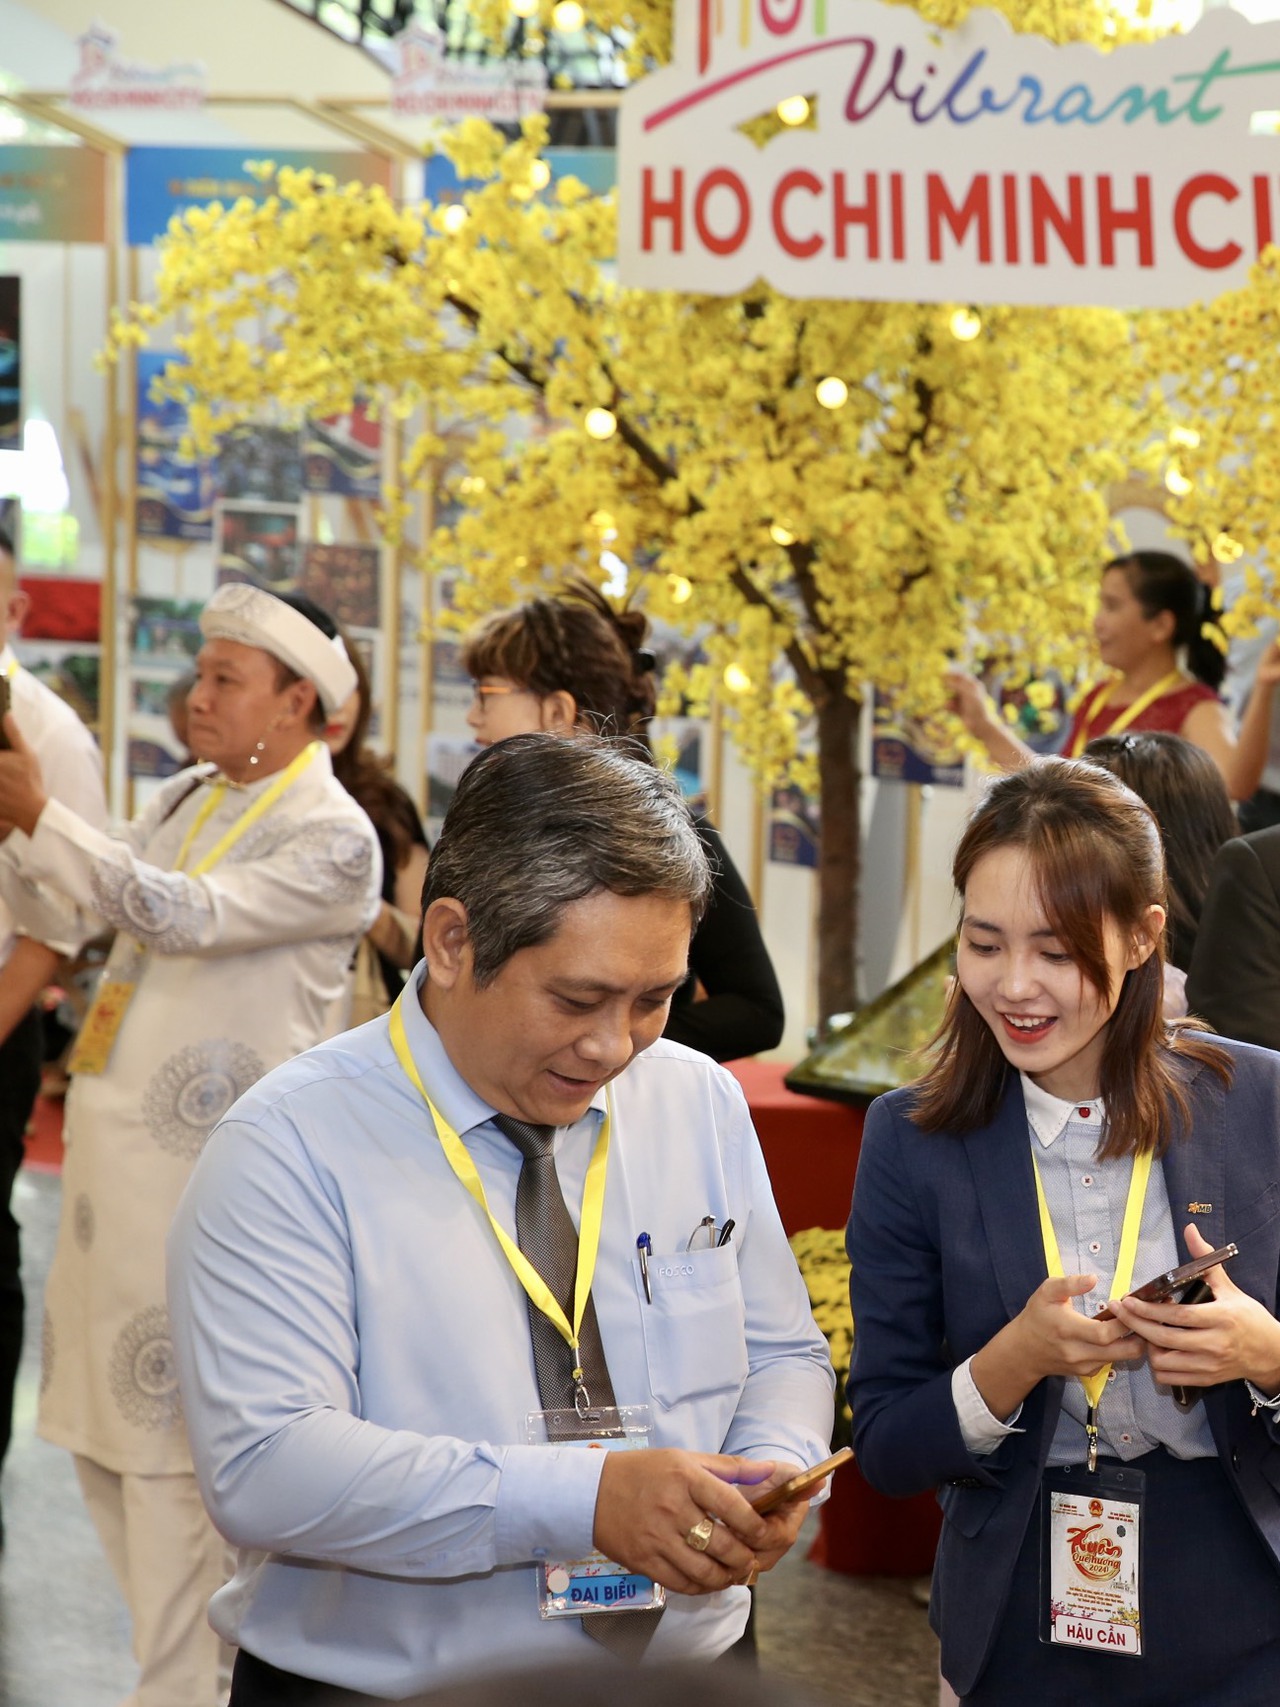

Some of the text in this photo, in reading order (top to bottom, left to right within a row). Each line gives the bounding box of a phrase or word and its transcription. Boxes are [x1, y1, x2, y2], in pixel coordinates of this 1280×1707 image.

[640, 167, 752, 257] HO
[770, 169, 906, 261] CHI
[925, 172, 1155, 267] MINH
[660, 1264, 695, 1277] FOSCO
[604, 1576, 637, 1600] BIỂU
[1067, 1622, 1126, 1646] HẬU CẦN
